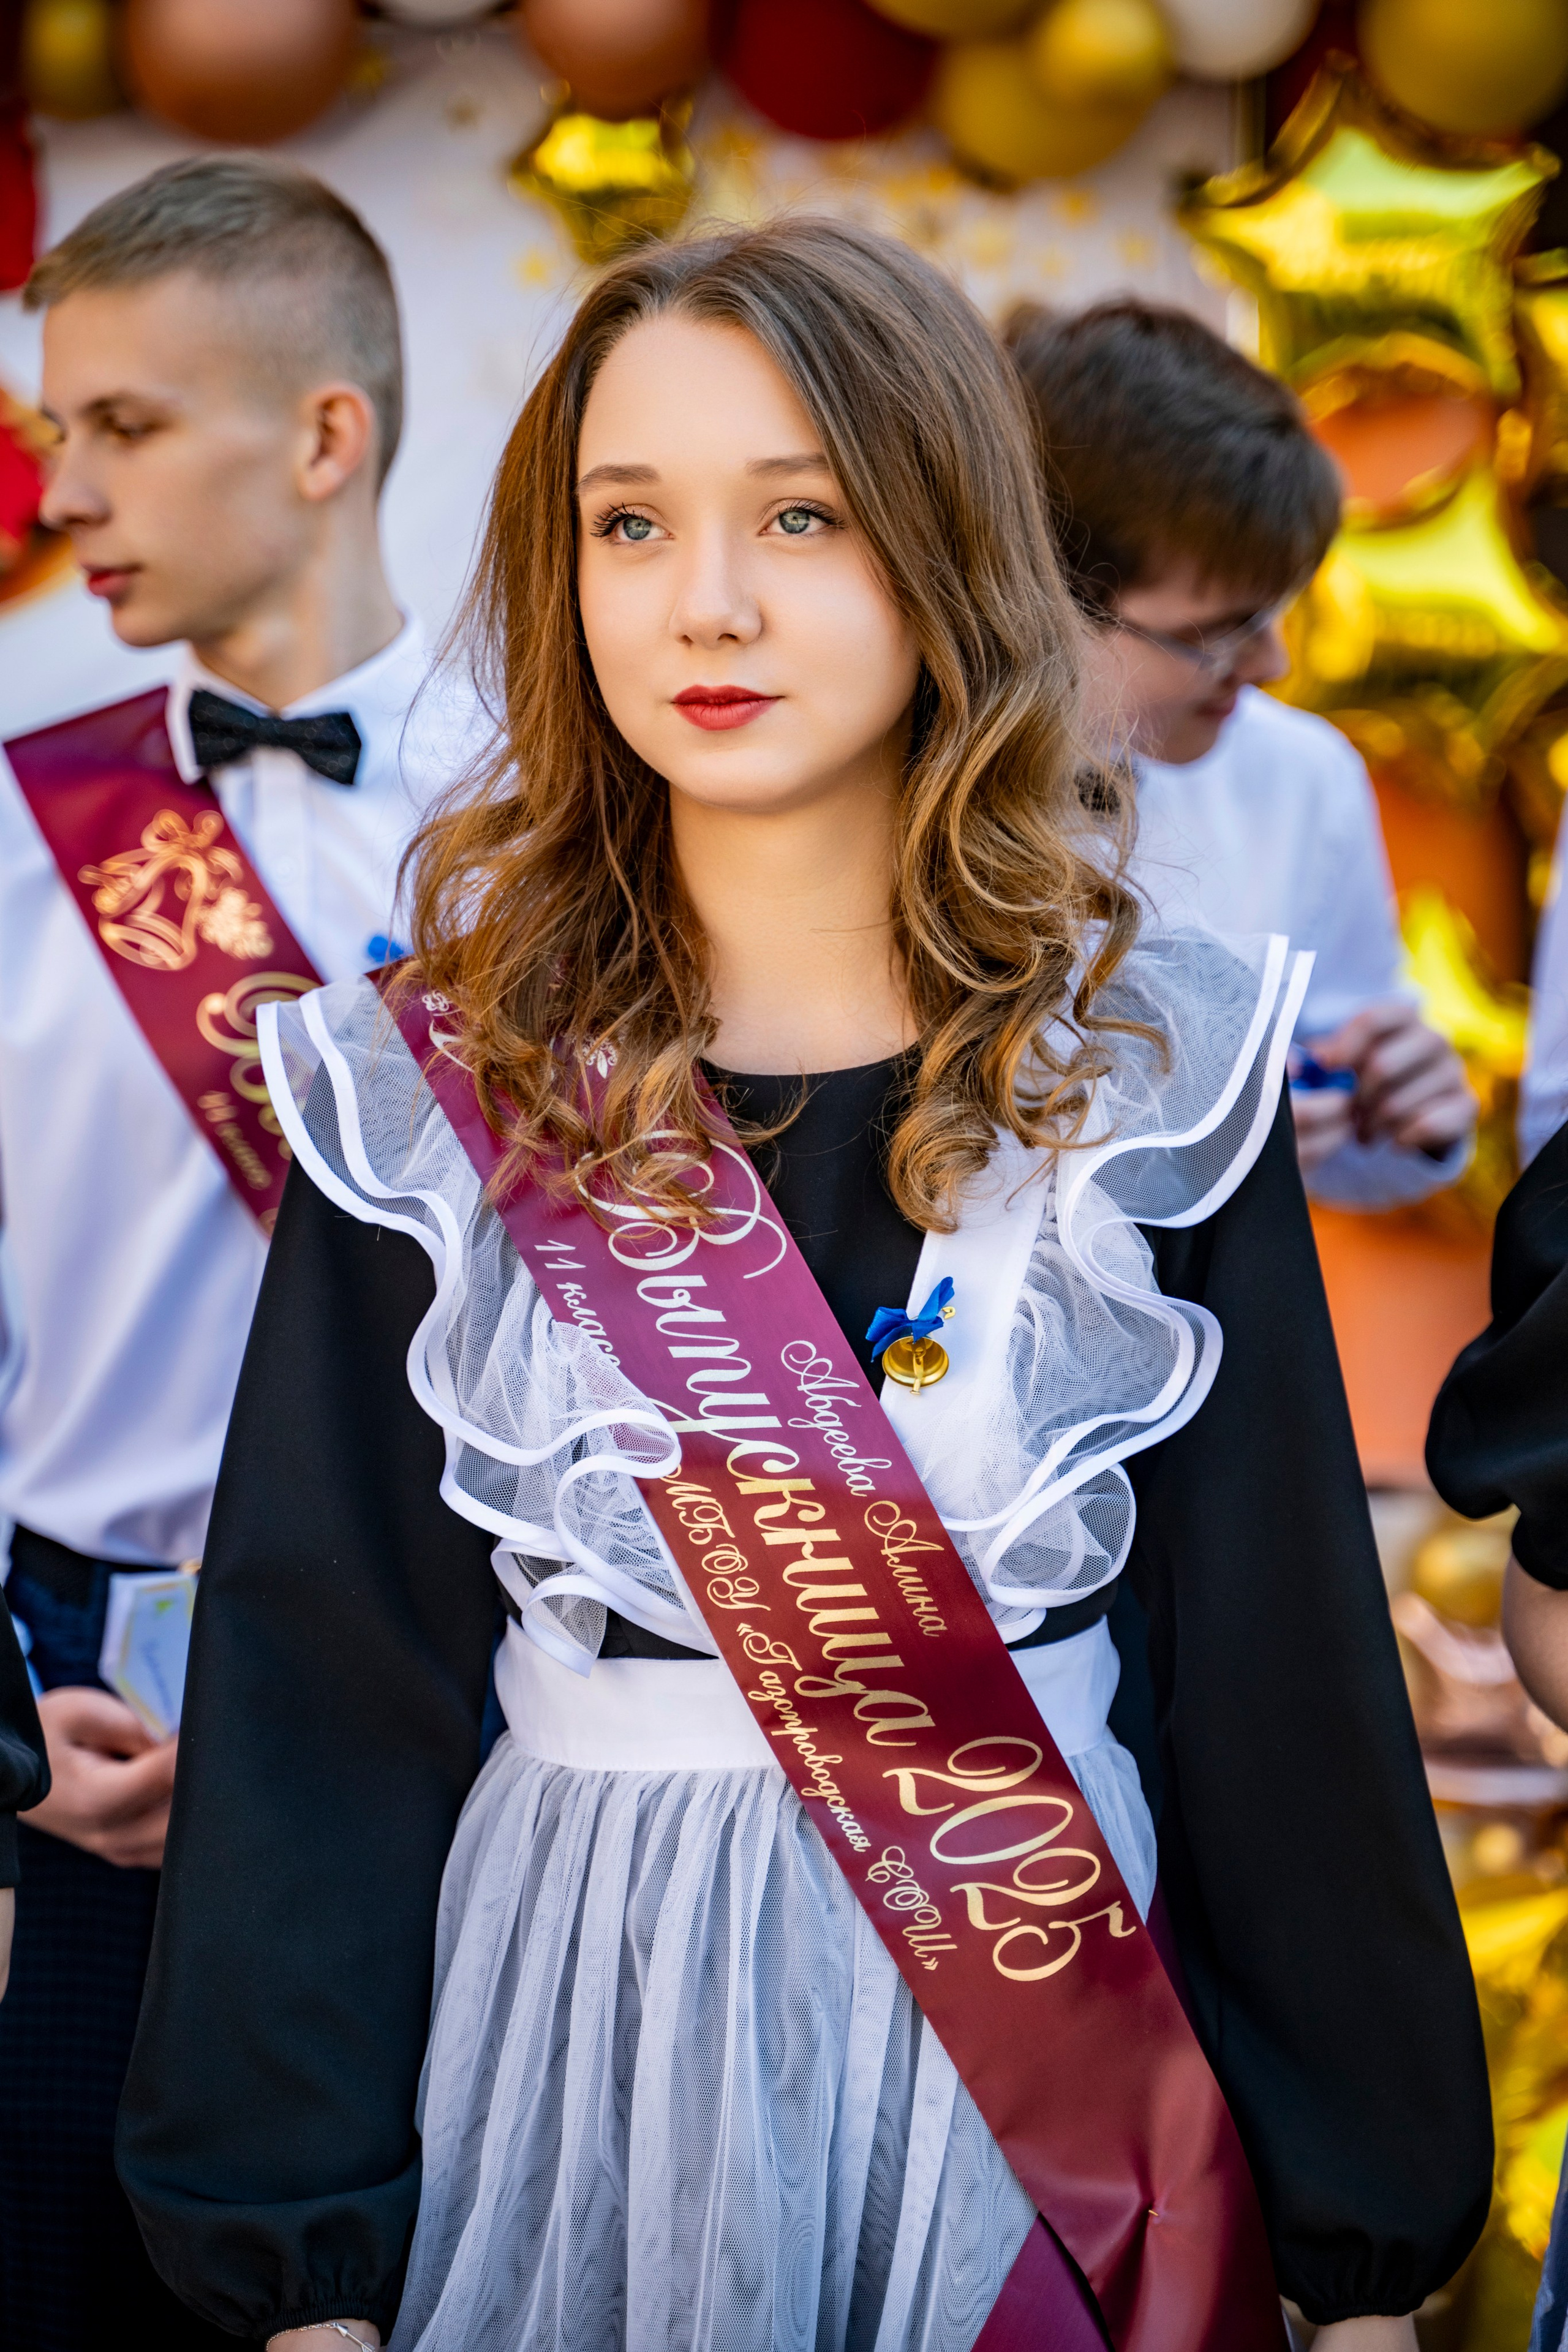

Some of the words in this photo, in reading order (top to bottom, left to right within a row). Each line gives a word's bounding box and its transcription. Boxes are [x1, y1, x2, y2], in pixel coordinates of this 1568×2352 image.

[534, 1240, 586, 1268] 11
[660, 1464, 772, 1611] МБОУ
[736, 1623, 871, 1852] «Газопроводская
[865, 1846, 958, 1971] СОШ»
[574, 1129, 935, 1747] Выпускница
[883, 1737, 1137, 1981] 2025
[781, 1340, 892, 1496] Абдеева
[864, 1501, 946, 1635] Алина
